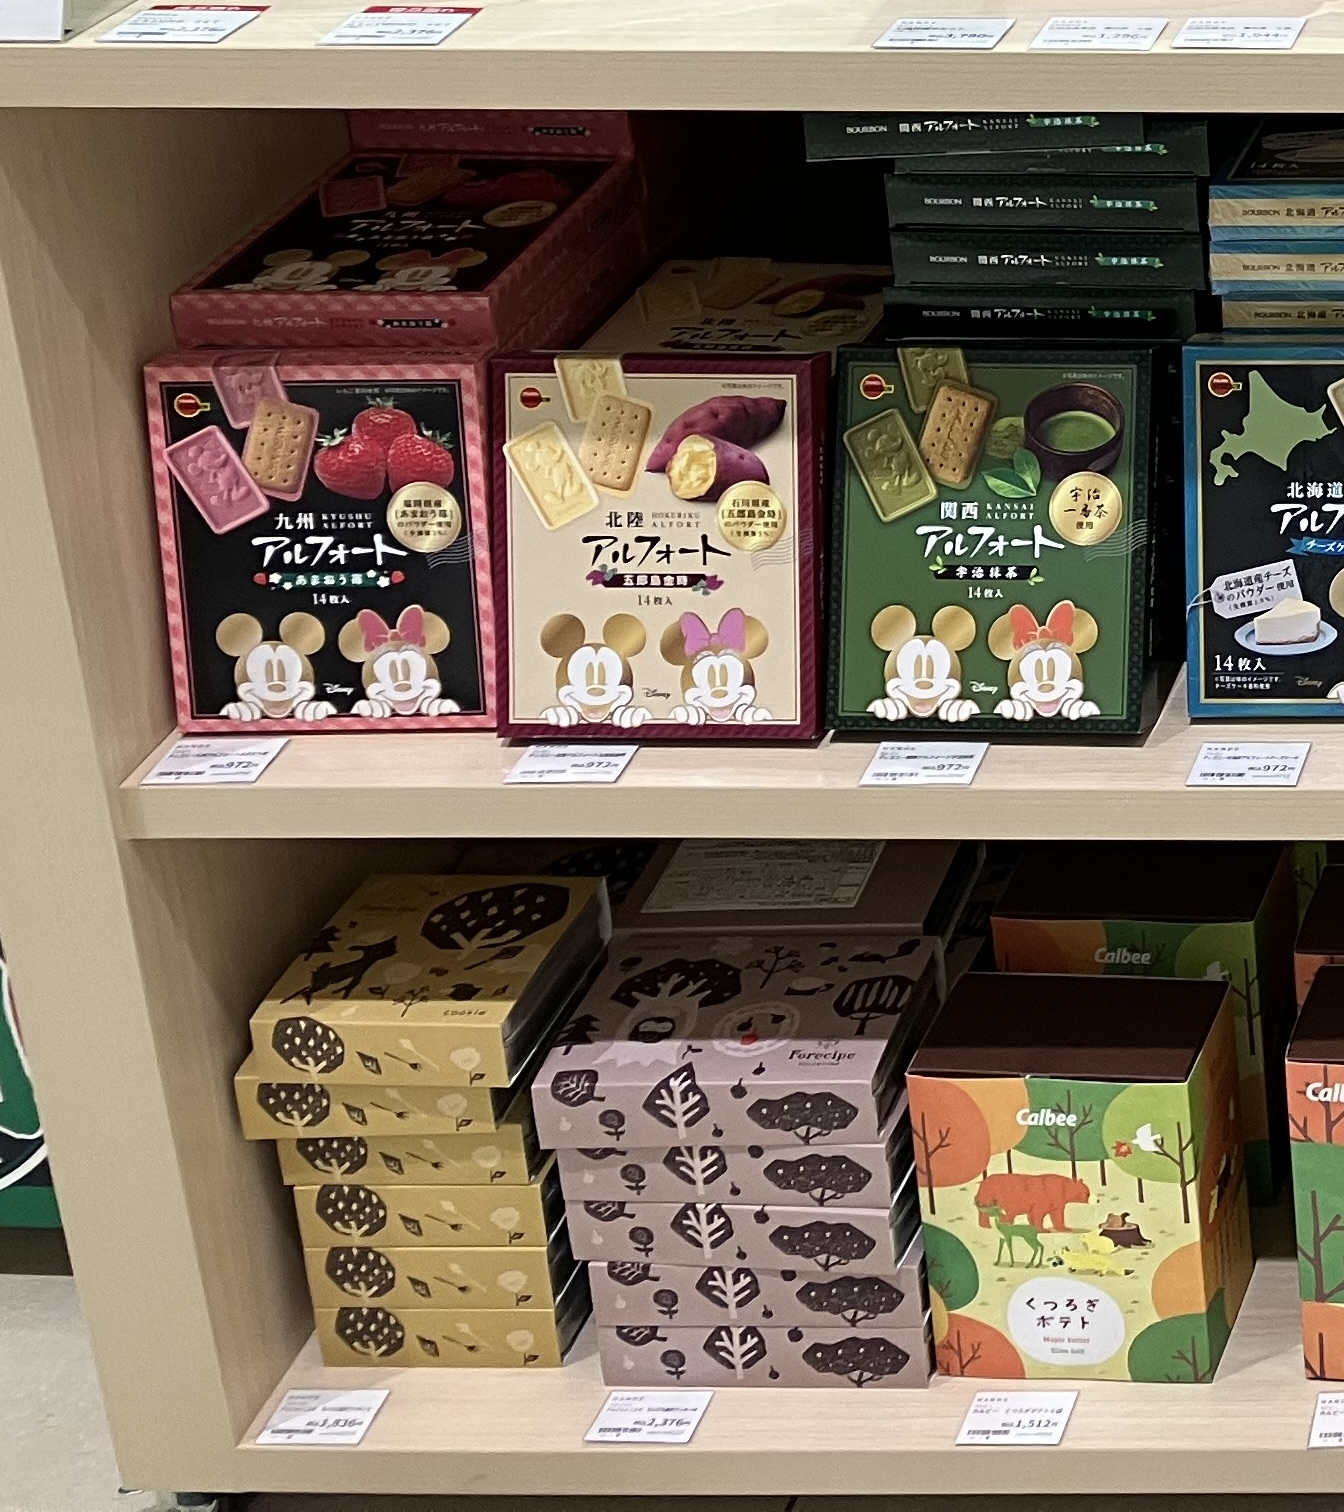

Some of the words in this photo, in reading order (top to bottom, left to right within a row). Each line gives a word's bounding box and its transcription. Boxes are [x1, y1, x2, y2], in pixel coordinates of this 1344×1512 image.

[1287, 482, 1343, 499] 北海道
[941, 501, 978, 520] 関西
[986, 503, 1034, 511] KANSAI
[274, 513, 314, 530] 九州
[605, 511, 643, 528] 北陸
[986, 512, 1034, 520] ALFORT
[582, 534, 731, 566] アルフォート
[915, 524, 1065, 559] アルフォート
[251, 533, 408, 568] アルフォート
[956, 566, 1018, 579] 宇治抹茶
[637, 595, 672, 606] 14枚入
[968, 587, 1004, 599] 14枚入
[1214, 654, 1267, 671] 14枚入
[1094, 946, 1151, 966] Calbee
[788, 1049, 856, 1062] Forecipe
[1015, 1108, 1078, 1129] Calbee
[1024, 1297, 1103, 1316] くつろぎ
[1035, 1315, 1092, 1332] ポテト
